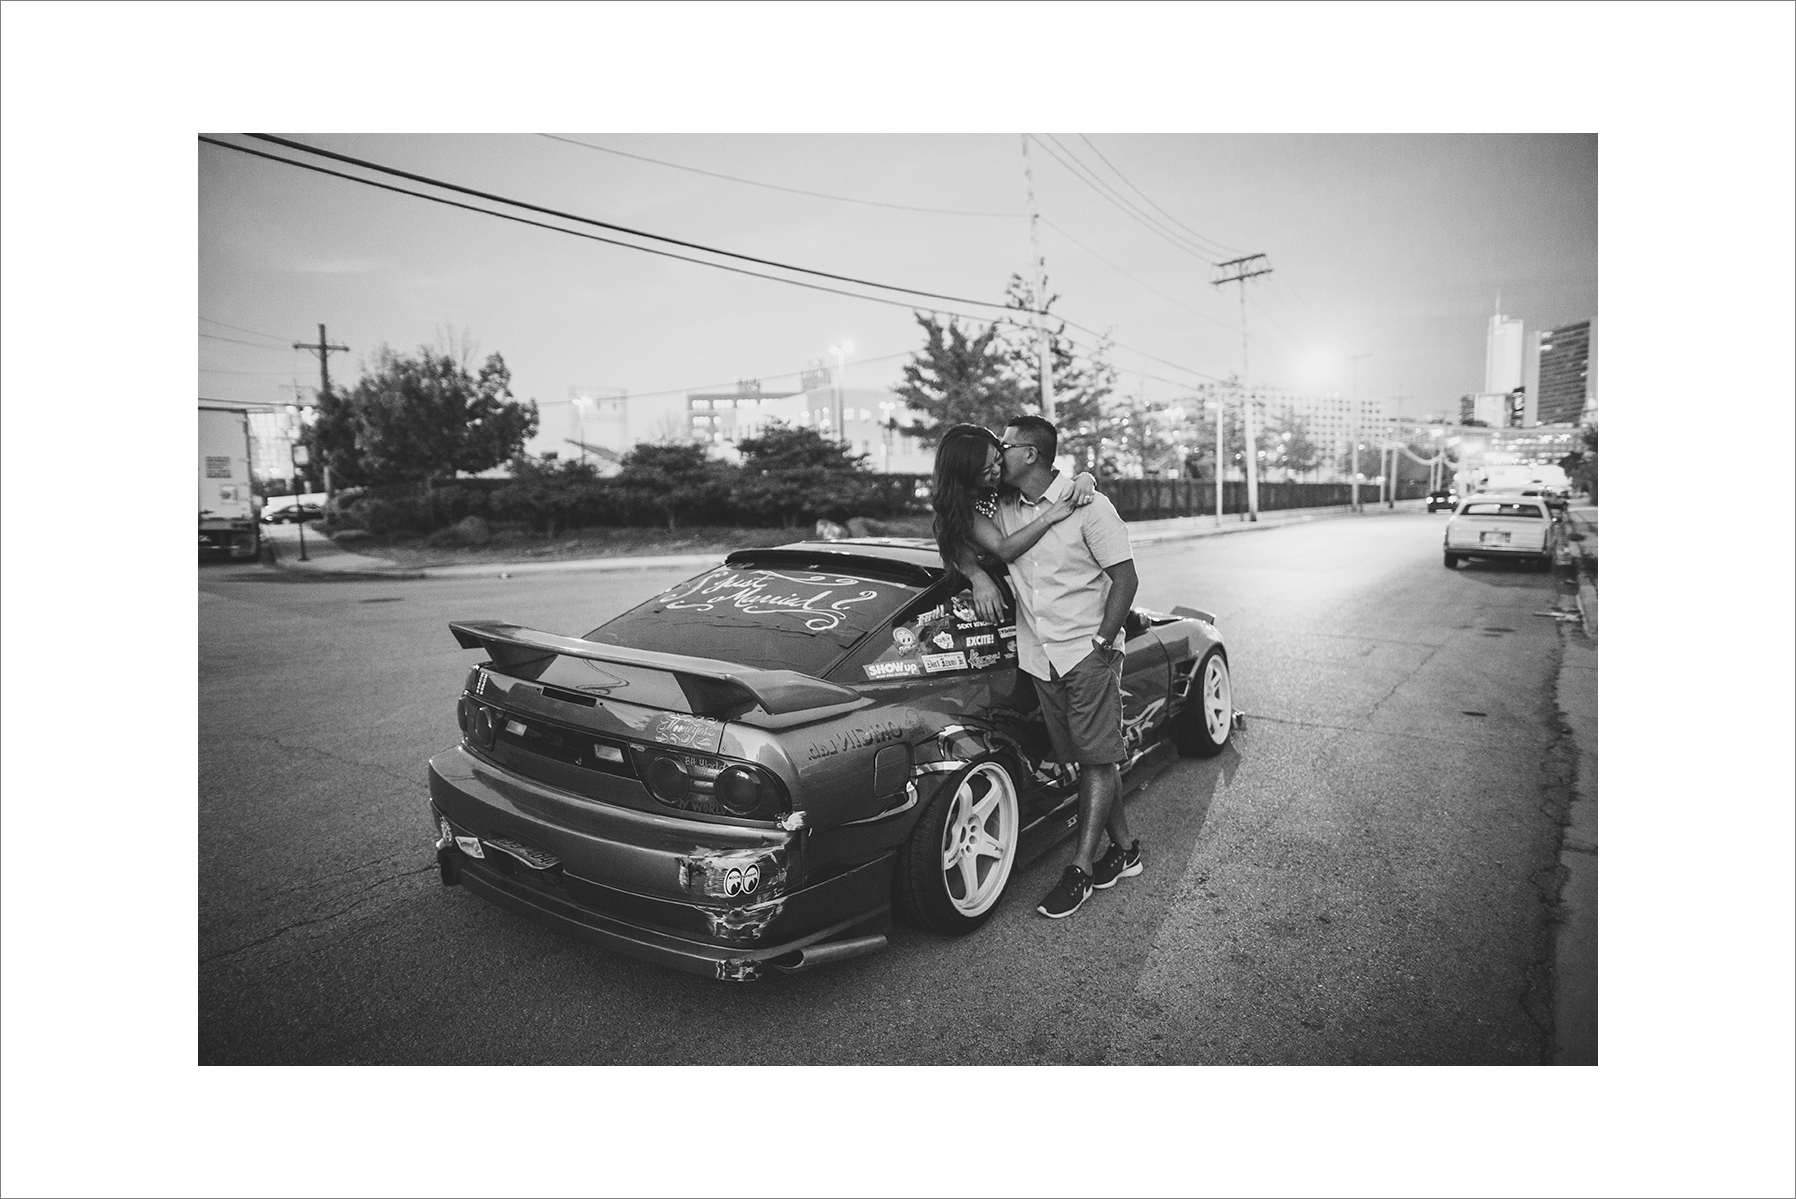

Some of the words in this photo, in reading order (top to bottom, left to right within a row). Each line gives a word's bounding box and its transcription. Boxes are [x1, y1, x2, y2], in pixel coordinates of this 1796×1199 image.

[966, 634, 994, 648] EXCITE!
[868, 661, 904, 676] SHOW
[904, 663, 917, 674] up
